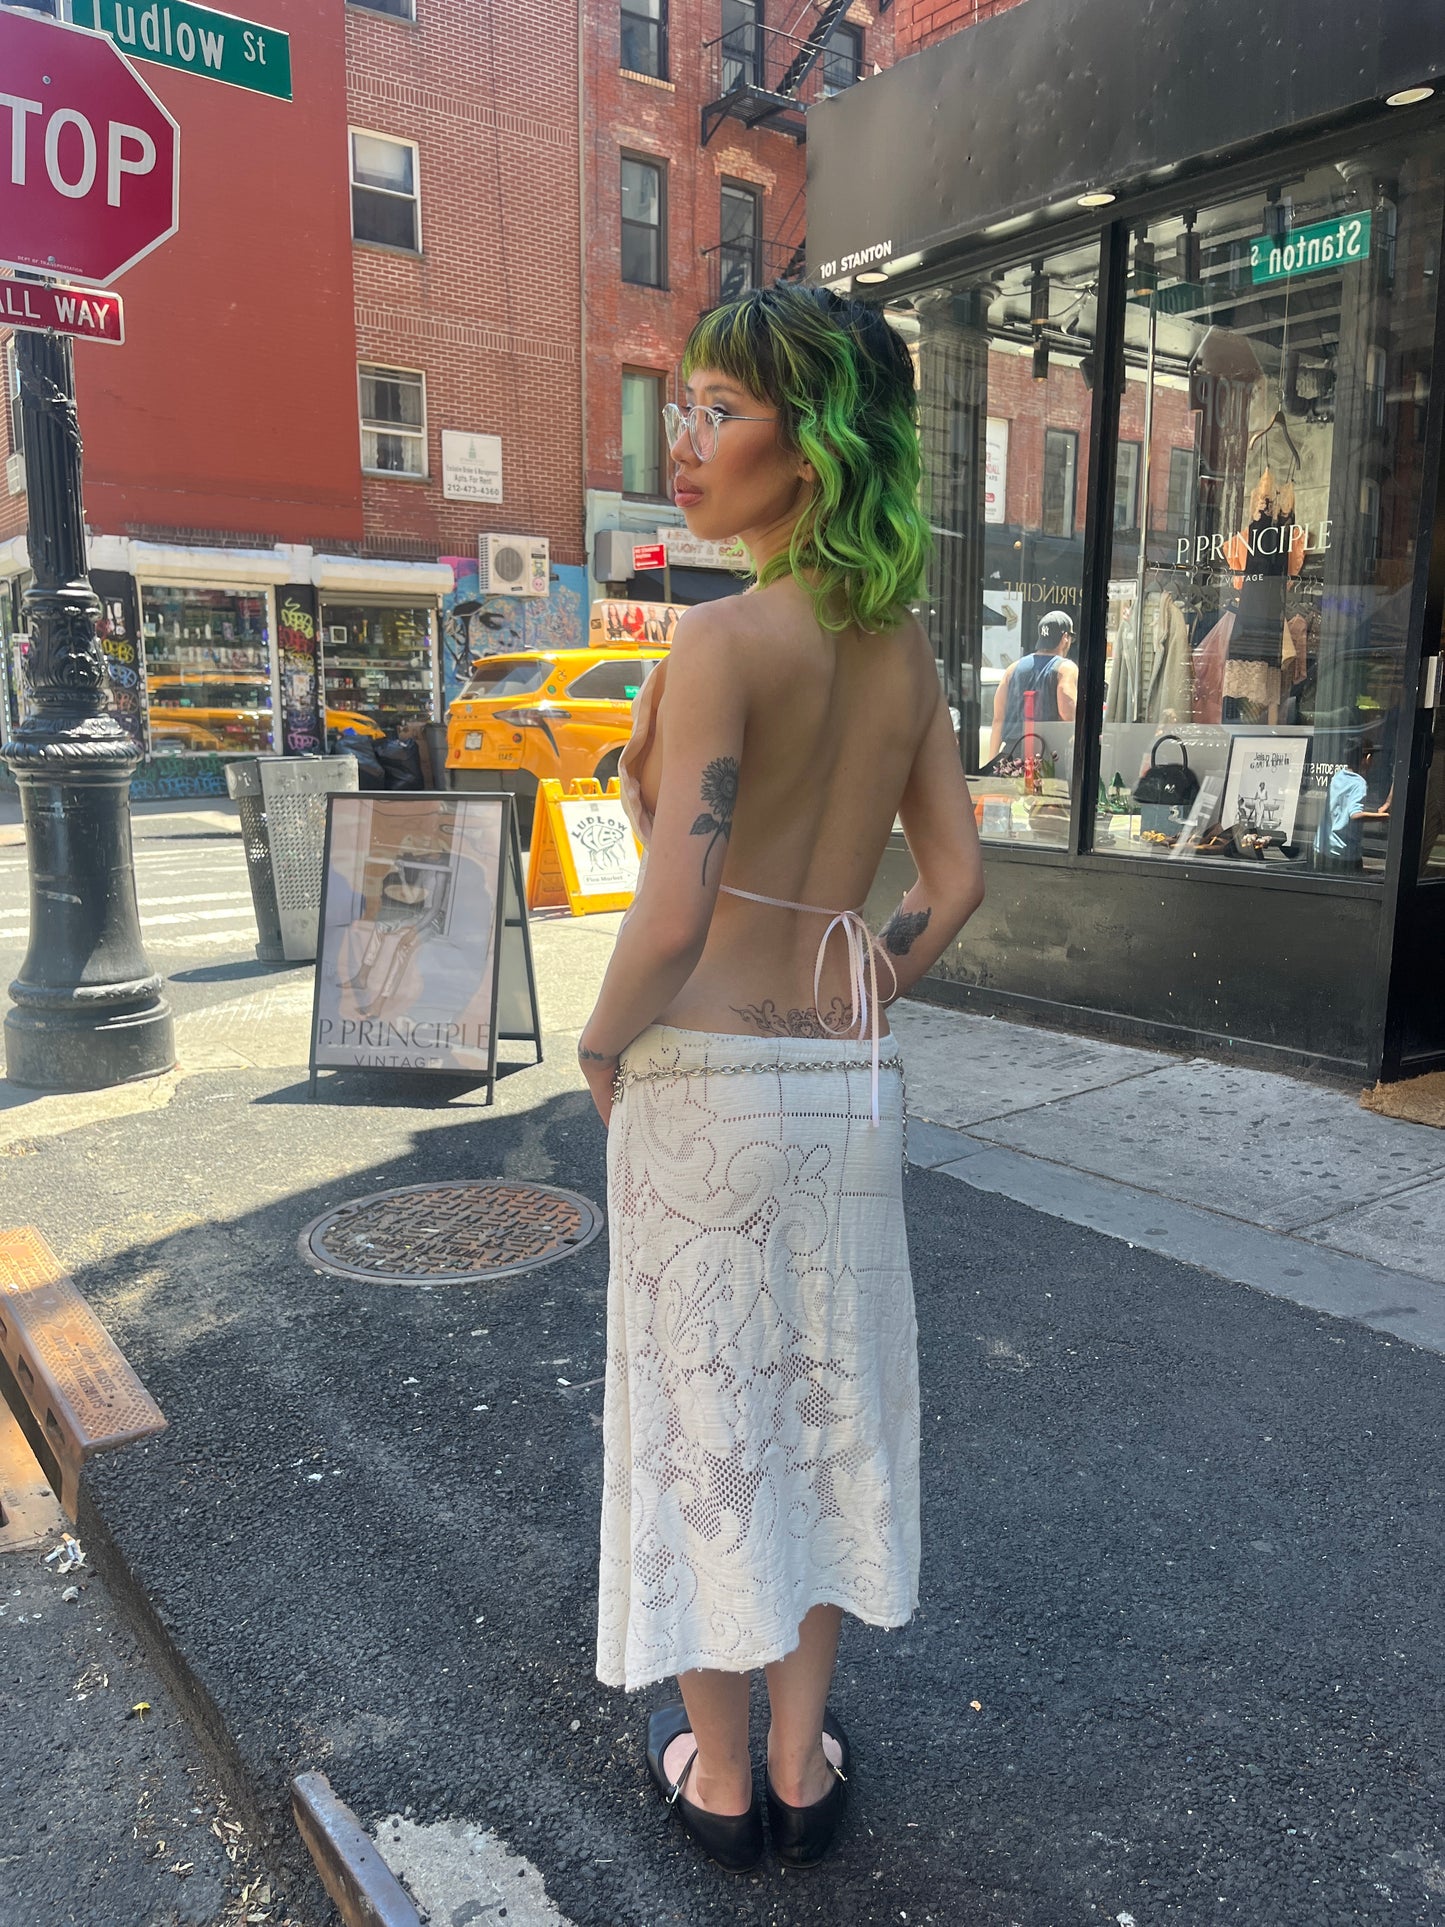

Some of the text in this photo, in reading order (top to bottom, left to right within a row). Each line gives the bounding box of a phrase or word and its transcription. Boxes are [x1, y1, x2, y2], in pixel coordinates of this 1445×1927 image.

[93, 0, 266, 70] Ludlow St
[0, 92, 156, 207] TOP
[820, 240, 891, 279] 101 STANTON
[54, 295, 109, 330] WAY
[572, 816, 627, 839] LUDLOW
